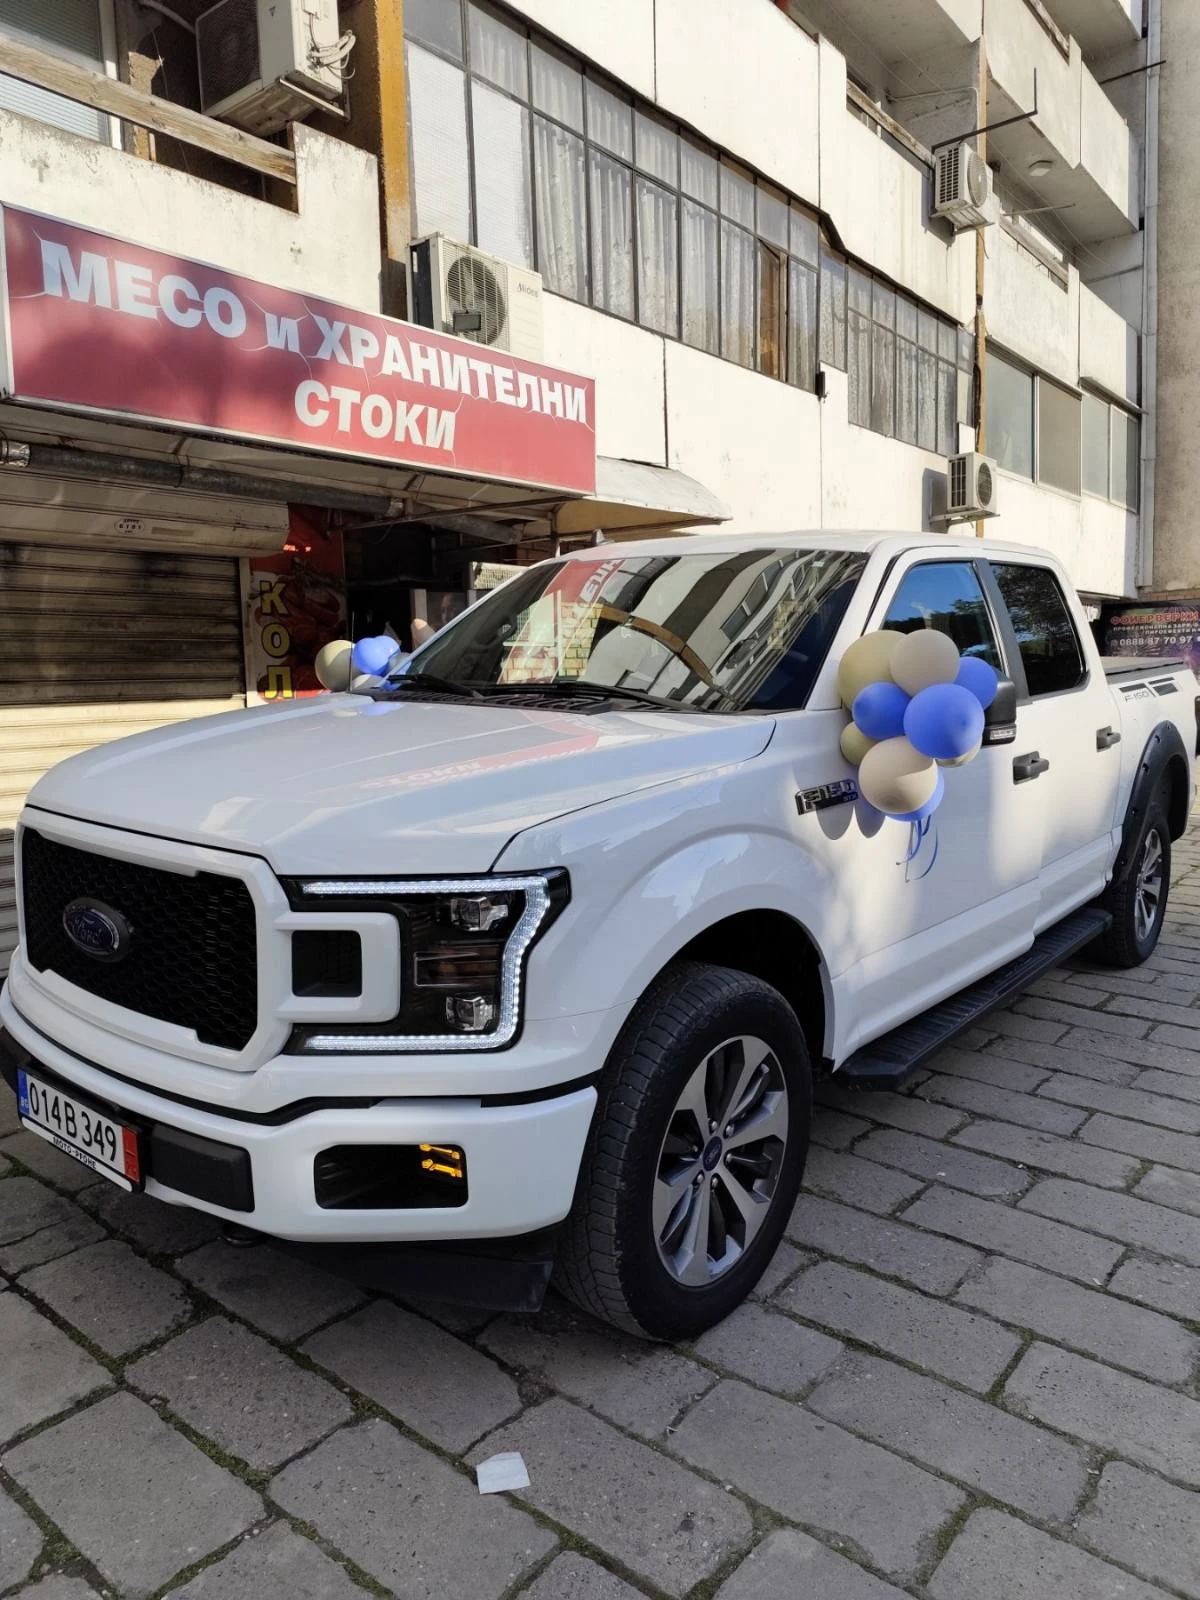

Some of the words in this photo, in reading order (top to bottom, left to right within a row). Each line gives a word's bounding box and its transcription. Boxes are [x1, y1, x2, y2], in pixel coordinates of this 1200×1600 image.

[41, 240, 247, 338] МЕСО
[313, 316, 588, 424] ХРАНИТЕЛНИ
[294, 379, 456, 451] СТОКИ
[1163, 636, 1177, 645] 70
[1179, 635, 1193, 644] 97
